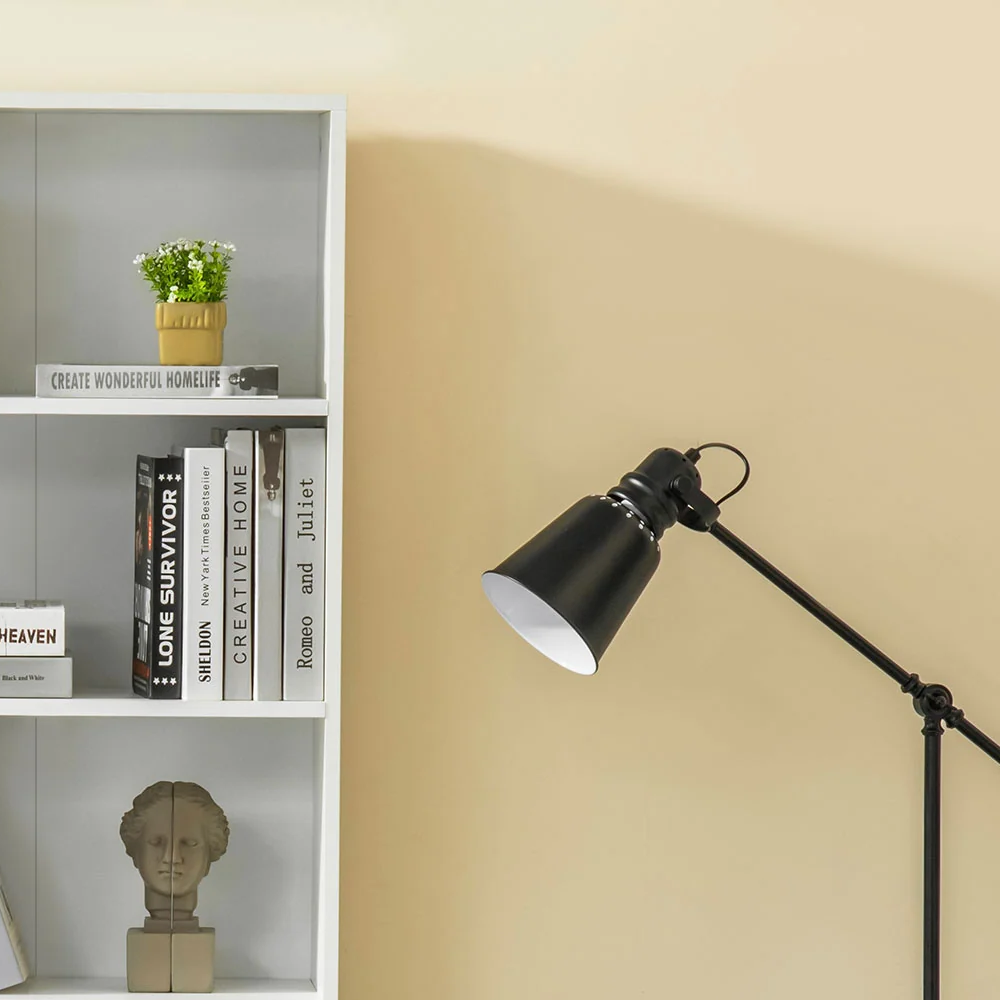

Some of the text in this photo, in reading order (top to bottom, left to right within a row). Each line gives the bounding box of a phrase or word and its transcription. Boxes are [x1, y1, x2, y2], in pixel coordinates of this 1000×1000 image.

[51, 369, 221, 390] CREATE WONDERFUL HOMELIFE
[200, 522, 210, 555] Times
[233, 465, 248, 664] CREATIVE HOME
[158, 488, 178, 667] LONE SURVIVOR
[200, 583, 210, 606] New
[296, 478, 316, 670] Romeo and Juliet
[198, 621, 212, 683] SHELDON
